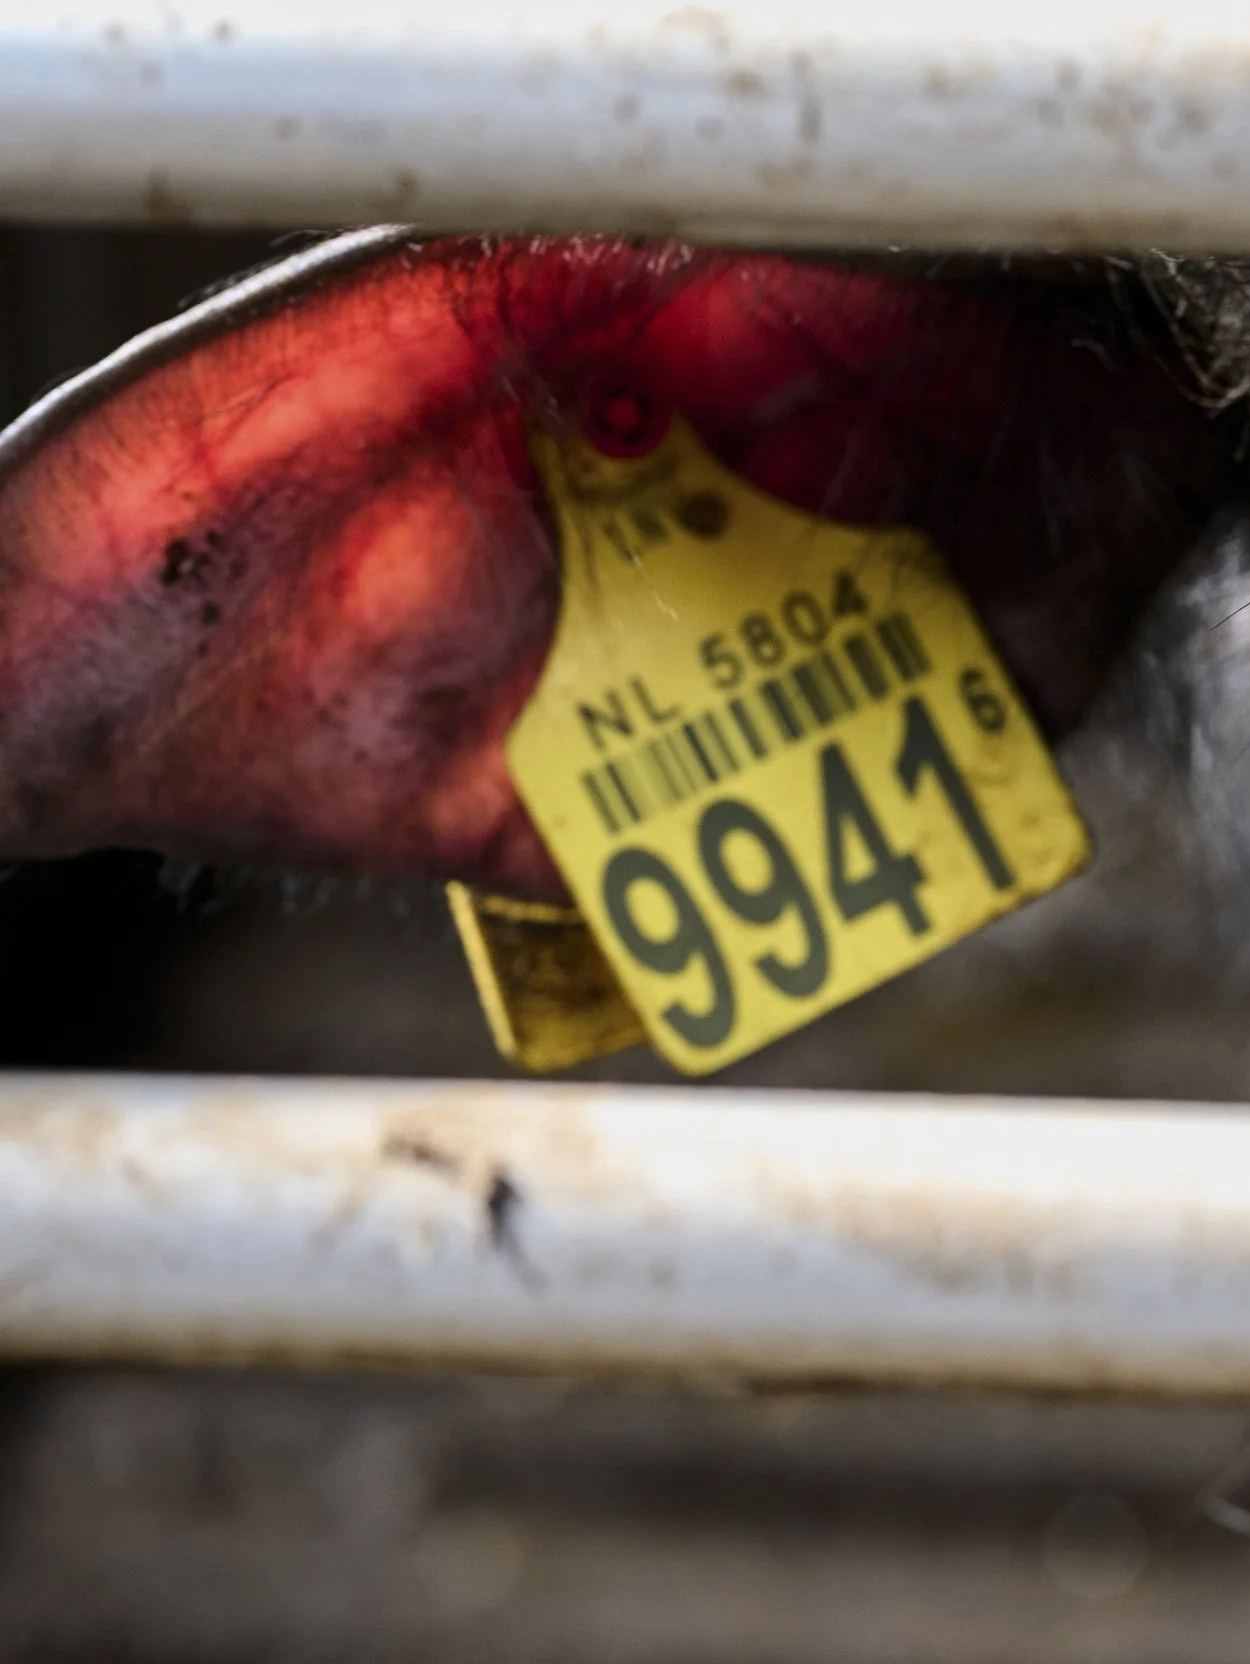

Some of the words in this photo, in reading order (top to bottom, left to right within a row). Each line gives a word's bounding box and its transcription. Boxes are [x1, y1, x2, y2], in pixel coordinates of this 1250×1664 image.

[576, 674, 682, 750] NL
[700, 571, 869, 690] 5804
[956, 667, 1006, 735] 6
[601, 693, 1016, 1050] 9941
